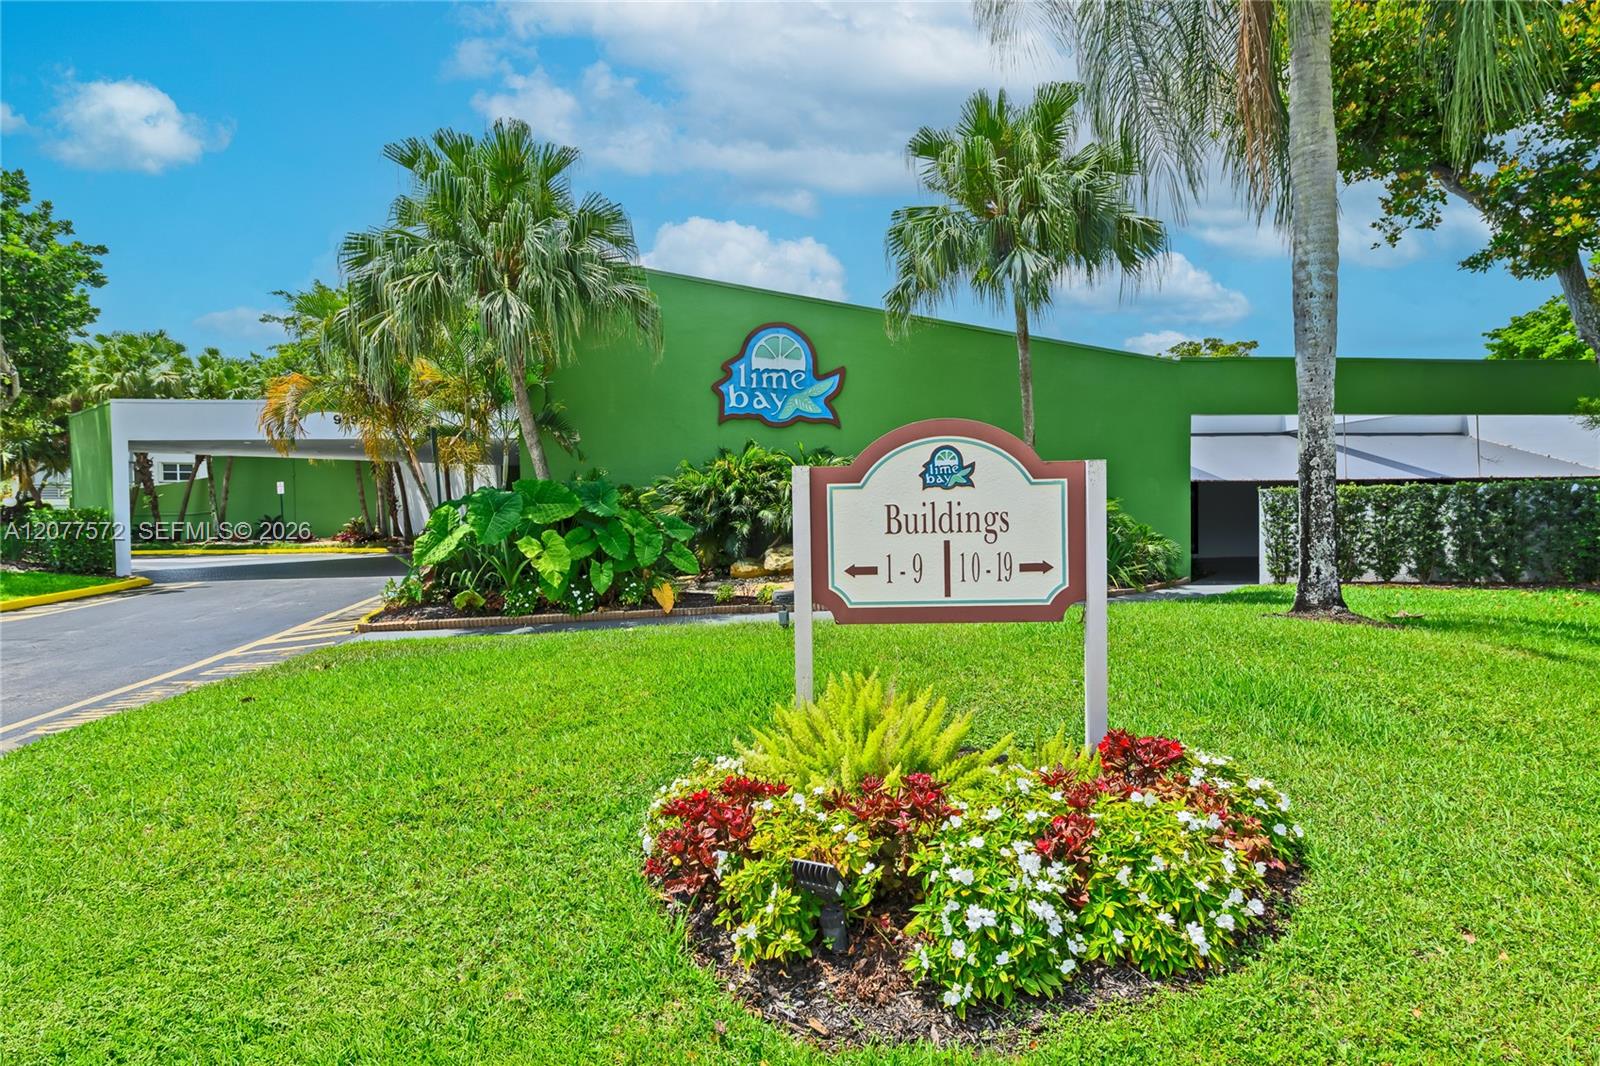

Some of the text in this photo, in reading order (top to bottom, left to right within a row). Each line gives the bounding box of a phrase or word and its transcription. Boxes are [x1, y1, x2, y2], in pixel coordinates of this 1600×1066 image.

[739, 363, 806, 390] lime
[729, 384, 787, 416] bay
[925, 473, 952, 486] bay
[929, 464, 959, 475] lime
[884, 501, 1010, 545] Buildings
